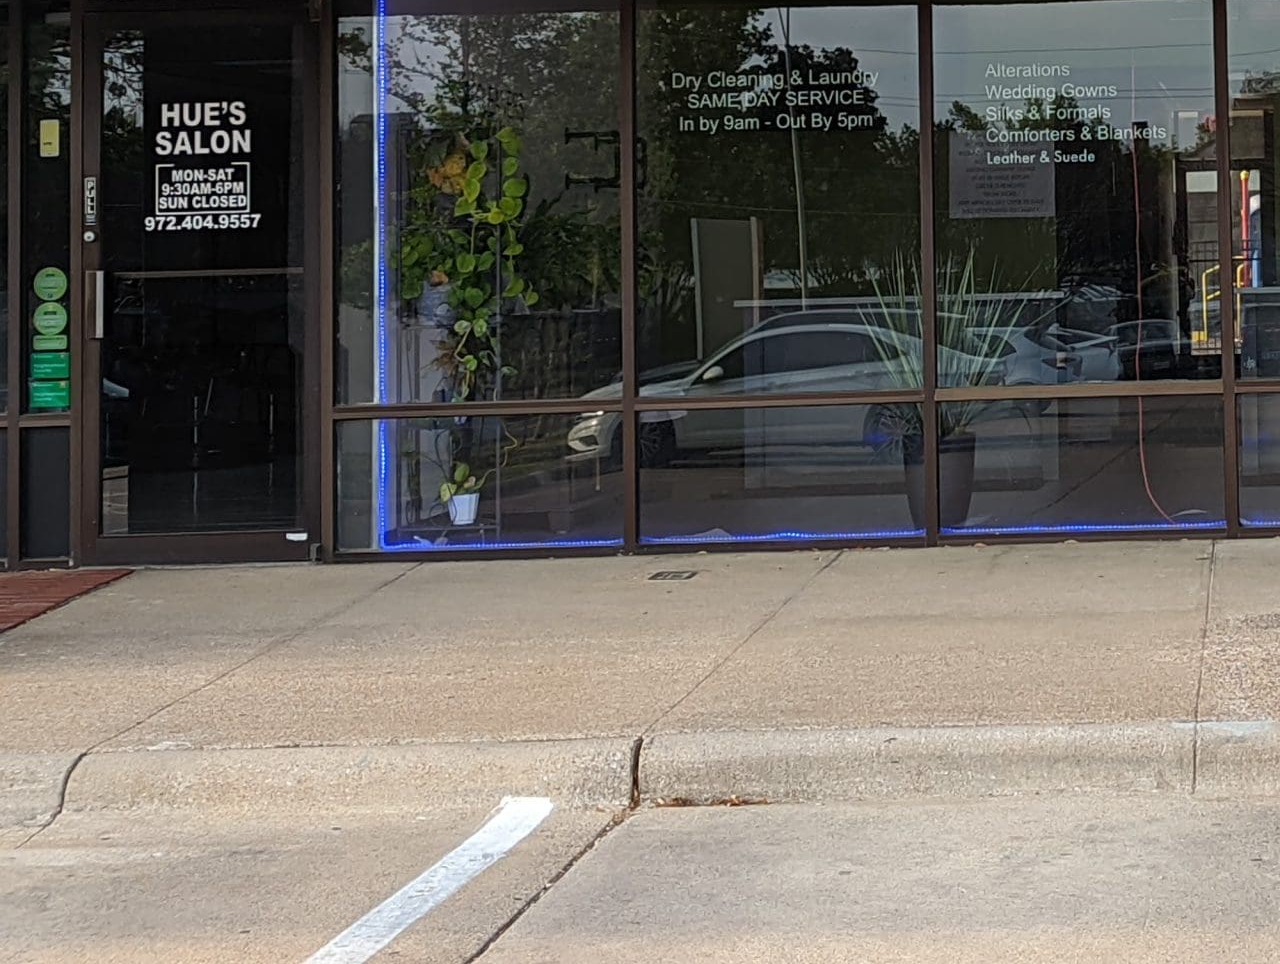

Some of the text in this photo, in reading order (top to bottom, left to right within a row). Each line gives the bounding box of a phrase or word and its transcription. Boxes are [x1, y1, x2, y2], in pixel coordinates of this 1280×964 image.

[671, 67, 879, 92] Dry Cleaning & Laundry
[985, 62, 1070, 78] Alterations
[687, 89, 864, 109] SAME DAY SERVICE
[985, 83, 1118, 102] Wedding Gowns
[161, 101, 247, 128] HUE'S
[986, 104, 1112, 122] Silks & Formals
[680, 116, 695, 132] In
[700, 116, 719, 134] by
[723, 114, 760, 131] 9am
[776, 112, 806, 130] Out
[811, 112, 832, 132] By
[837, 113, 874, 129] 5pm
[155, 129, 252, 156] SALON
[986, 125, 1167, 144] Comforters & Blankets
[987, 148, 1096, 165] Leather & Suede
[171, 168, 235, 183] MON-SAT
[161, 181, 245, 196] 9:30AM-6PM
[159, 194, 248, 210] SUN CLOSED
[143, 213, 262, 232] 972.404.9557
